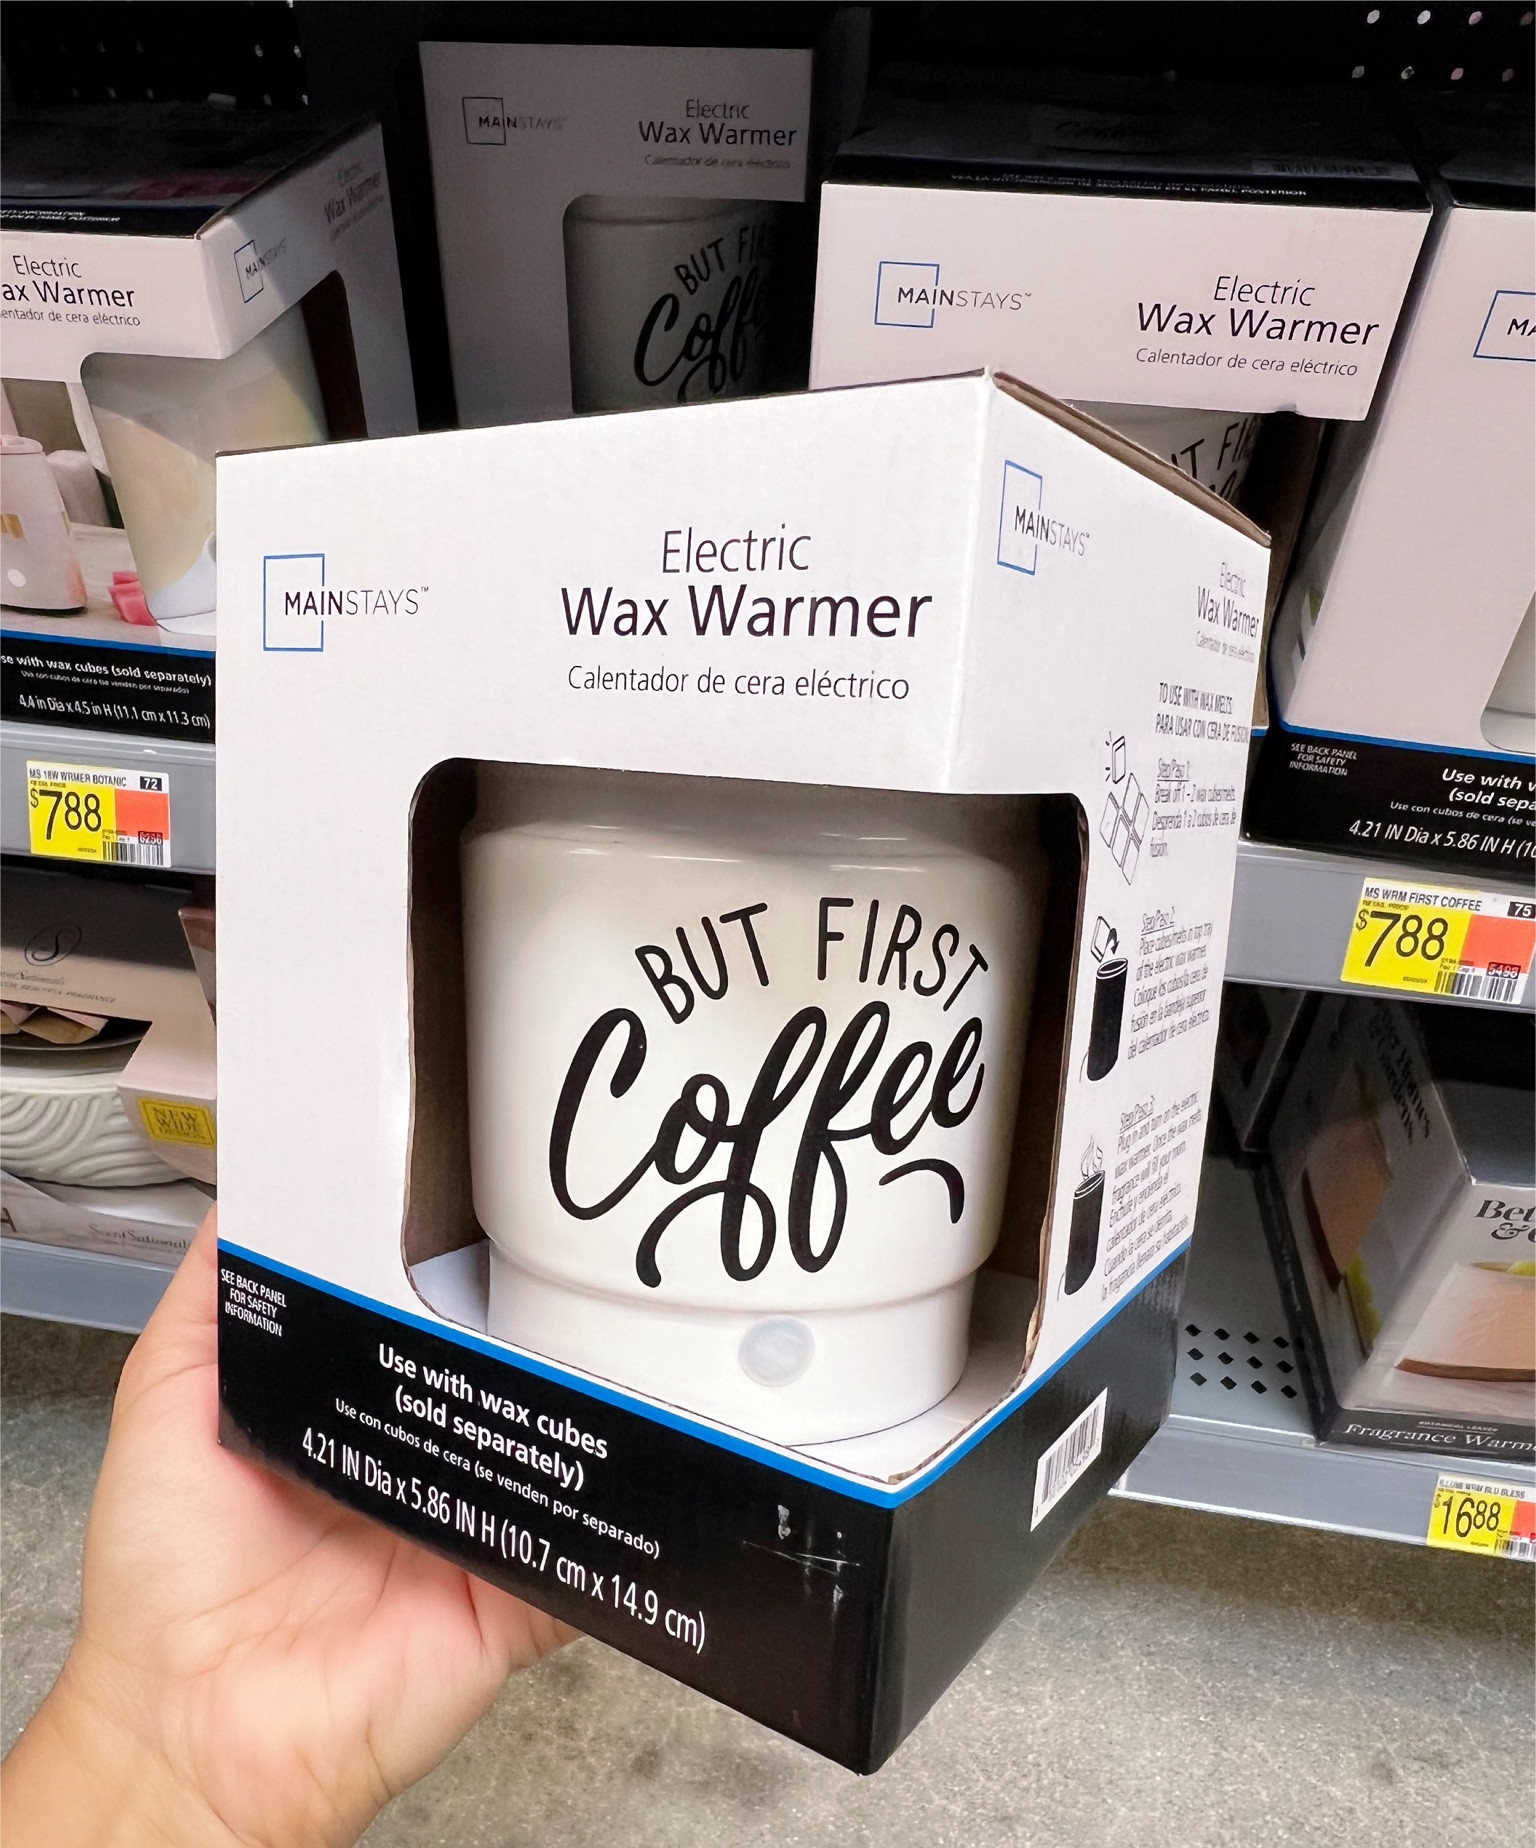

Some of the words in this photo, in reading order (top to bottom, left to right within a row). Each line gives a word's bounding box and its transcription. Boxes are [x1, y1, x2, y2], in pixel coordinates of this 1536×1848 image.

[686, 99, 750, 119] Electric
[638, 120, 691, 145] Wax
[699, 122, 798, 146] Warmer
[12, 255, 83, 278] Electric
[674, 227, 724, 296] BUT
[1, 283, 30, 302] ax
[32, 280, 135, 308] Warmer
[1213, 275, 1316, 307] Electric
[0, 309, 44, 321] entador
[49, 310, 63, 323] de
[65, 313, 90, 323] cera
[92, 313, 141, 327] eléctrico
[1137, 302, 1216, 336] Wax
[1230, 306, 1380, 346] Warmer
[1136, 347, 1223, 369] Calentador
[1226, 353, 1247, 370] de
[1250, 357, 1285, 373] cera
[1289, 358, 1358, 378] eléctrico
[661, 523, 813, 575] Electric
[560, 585, 670, 638] Wax
[687, 582, 933, 639] Warmer
[1197, 586, 1220, 625] Wax
[1222, 596, 1260, 639] Warmer
[1, 655, 14, 664] se
[16, 656, 44, 668] with
[46, 660, 72, 671] wax
[75, 662, 109, 675] cubes
[111, 665, 142, 679] (sold
[144, 668, 212, 687] separately)
[567, 664, 690, 696] Calentador
[695, 669, 726, 696] de
[733, 673, 786, 698] cera
[794, 667, 910, 701] eléctrico
[49, 697, 66, 713] Dia
[104, 703, 113, 718] H
[1291, 743, 1306, 753] SEE
[1307, 745, 1330, 756] BACK
[1297, 753, 1314, 763] FOR
[144, 778, 158, 790] 72
[1442, 768, 1475, 784] Use
[1480, 774, 1522, 790] with
[1390, 801, 1409, 810] Use
[1432, 807, 1463, 818] cubos
[1465, 811, 1480, 819] de
[1482, 814, 1505, 823] cera
[1448, 787, 1495, 805] (sold
[1349, 820, 1382, 838] 4.21
[1384, 824, 1403, 840] IN
[1404, 826, 1429, 844] Dia
[1430, 834, 1442, 846] x
[1443, 831, 1480, 850] 5.86
[1480, 836, 1500, 853] IN
[1500, 838, 1516, 855] H
[1364, 887, 1379, 899] MS
[1382, 889, 1407, 902] WRM
[1409, 892, 1439, 906] FIRST
[1440, 896, 1483, 911] COFFEE
[1514, 903, 1532, 917] 75
[635, 902, 768, 1025] BUT
[817, 897, 989, 1012] FIRST
[549, 1000, 985, 1288] Coffee
[221, 1268, 235, 1286] SEE
[236, 1274, 259, 1295] BACK
[260, 1284, 287, 1308] PANEL
[230, 1288, 246, 1306] FOR
[247, 1295, 278, 1319] SAFETY
[225, 1301, 283, 1338] INFORMATION
[378, 1343, 417, 1379] Use
[423, 1363, 473, 1403] with
[480, 1387, 530, 1427] wax
[537, 1412, 608, 1459] cubes
[394, 1384, 447, 1428] (sold
[453, 1412, 585, 1492] separately)
[1345, 1424, 1457, 1444] Fragrance
[335, 1397, 357, 1416] Use
[360, 1411, 382, 1431] con
[384, 1422, 421, 1449] cubos
[423, 1437, 440, 1456] de
[443, 1450, 472, 1473] cera
[474, 1461, 494, 1482] (se
[497, 1472, 549, 1508] venden
[553, 1499, 580, 1524] por
[582, 1511, 661, 1560] separado)
[302, 1426, 337, 1470] 4.21
[342, 1444, 361, 1483] IN
[364, 1455, 392, 1498] Dia
[396, 1479, 408, 1507] x
[411, 1477, 451, 1525] 5.86
[456, 1497, 477, 1539] IN
[481, 1511, 496, 1549] H
[500, 1517, 551, 1574] (10.7
[557, 1554, 588, 1594] cm
[592, 1571, 605, 1602] x
[612, 1573, 659, 1627] 14.9
[665, 1610, 706, 1656] cm)
